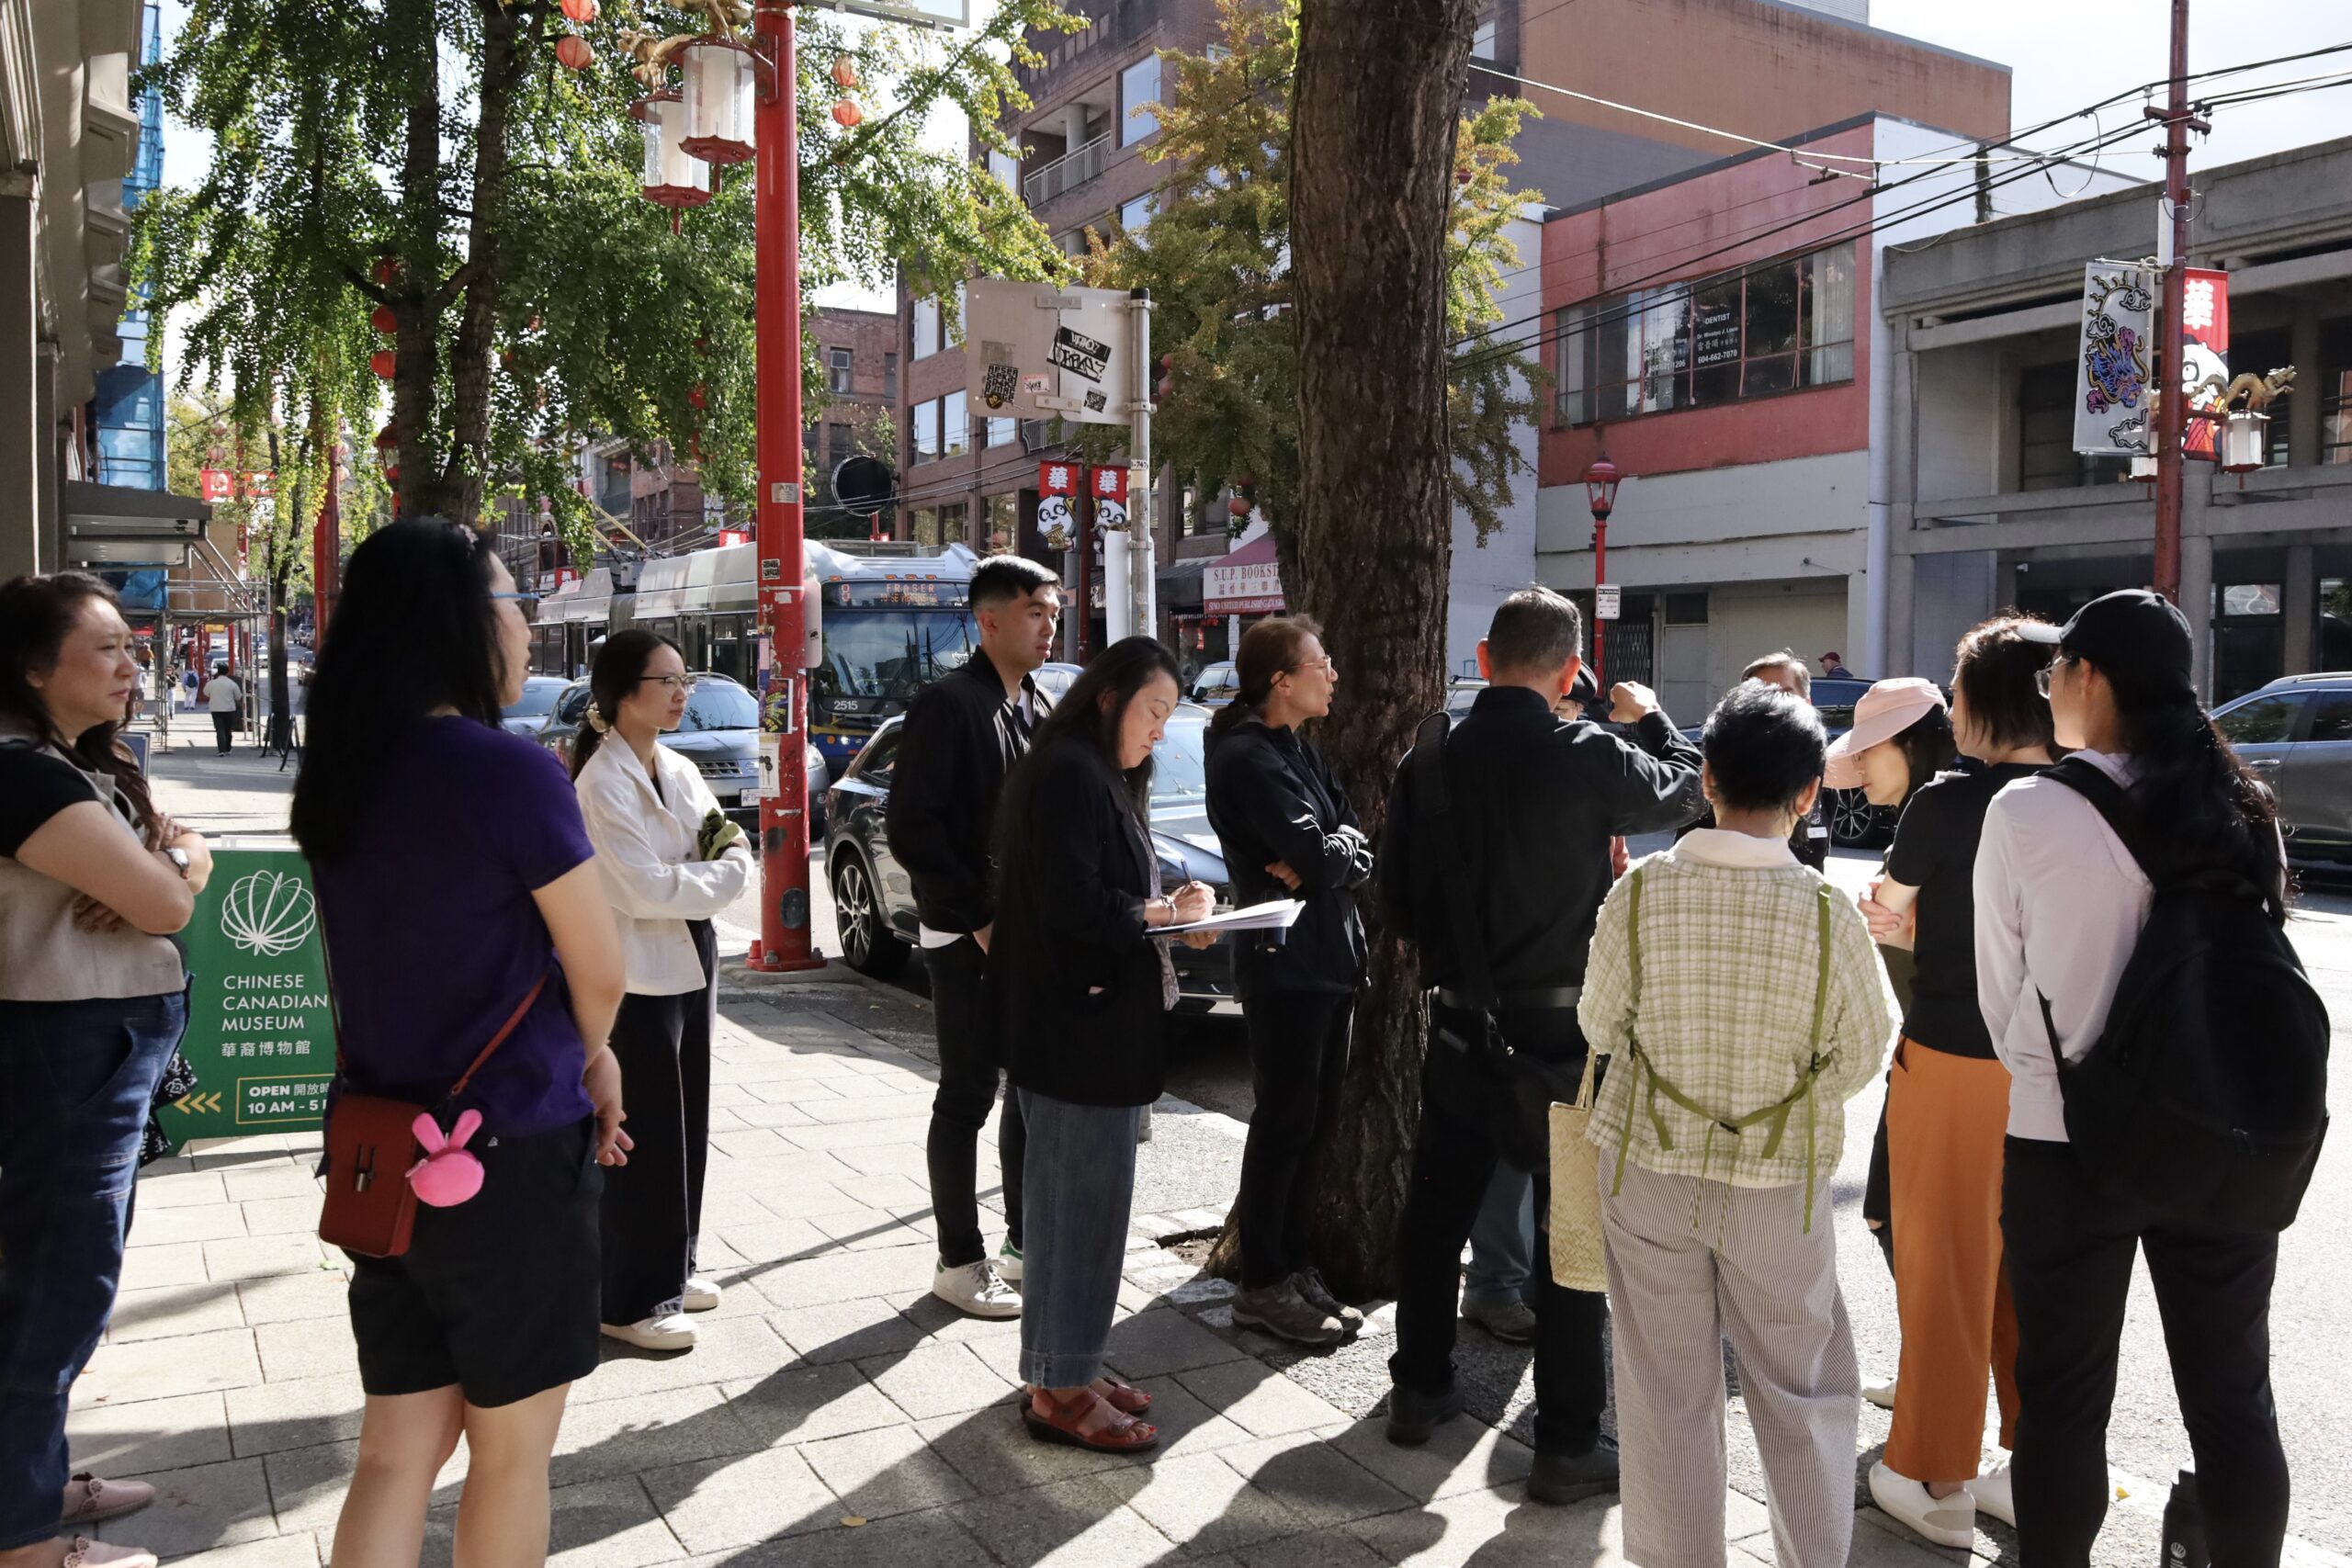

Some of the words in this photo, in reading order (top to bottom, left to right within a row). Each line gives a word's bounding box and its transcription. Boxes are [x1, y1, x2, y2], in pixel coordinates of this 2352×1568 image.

[1704, 313, 1730, 324] DENTIST
[1697, 350, 1737, 364] 604-662-7070
[1047, 466, 1069, 490] 華
[1098, 469, 1118, 493] 華
[1214, 569, 1238, 581] S.U.P.
[1241, 564, 1280, 579] BOOKST
[886, 583, 935, 593] FRASER
[1208, 601, 1220, 611] SINO
[1221, 600, 1239, 611] UNITED
[833, 700, 858, 711] 2515
[223, 975, 304, 989] CHINESE
[222, 994, 328, 1011] CANADIAN
[221, 1015, 305, 1032] MUSEUM
[220, 1040, 311, 1057] 華裔博物館
[249, 1084, 290, 1098] OPEN
[247, 1102, 266, 1114] 10
[268, 1100, 295, 1113] AM
[309, 1100, 319, 1111] 5
